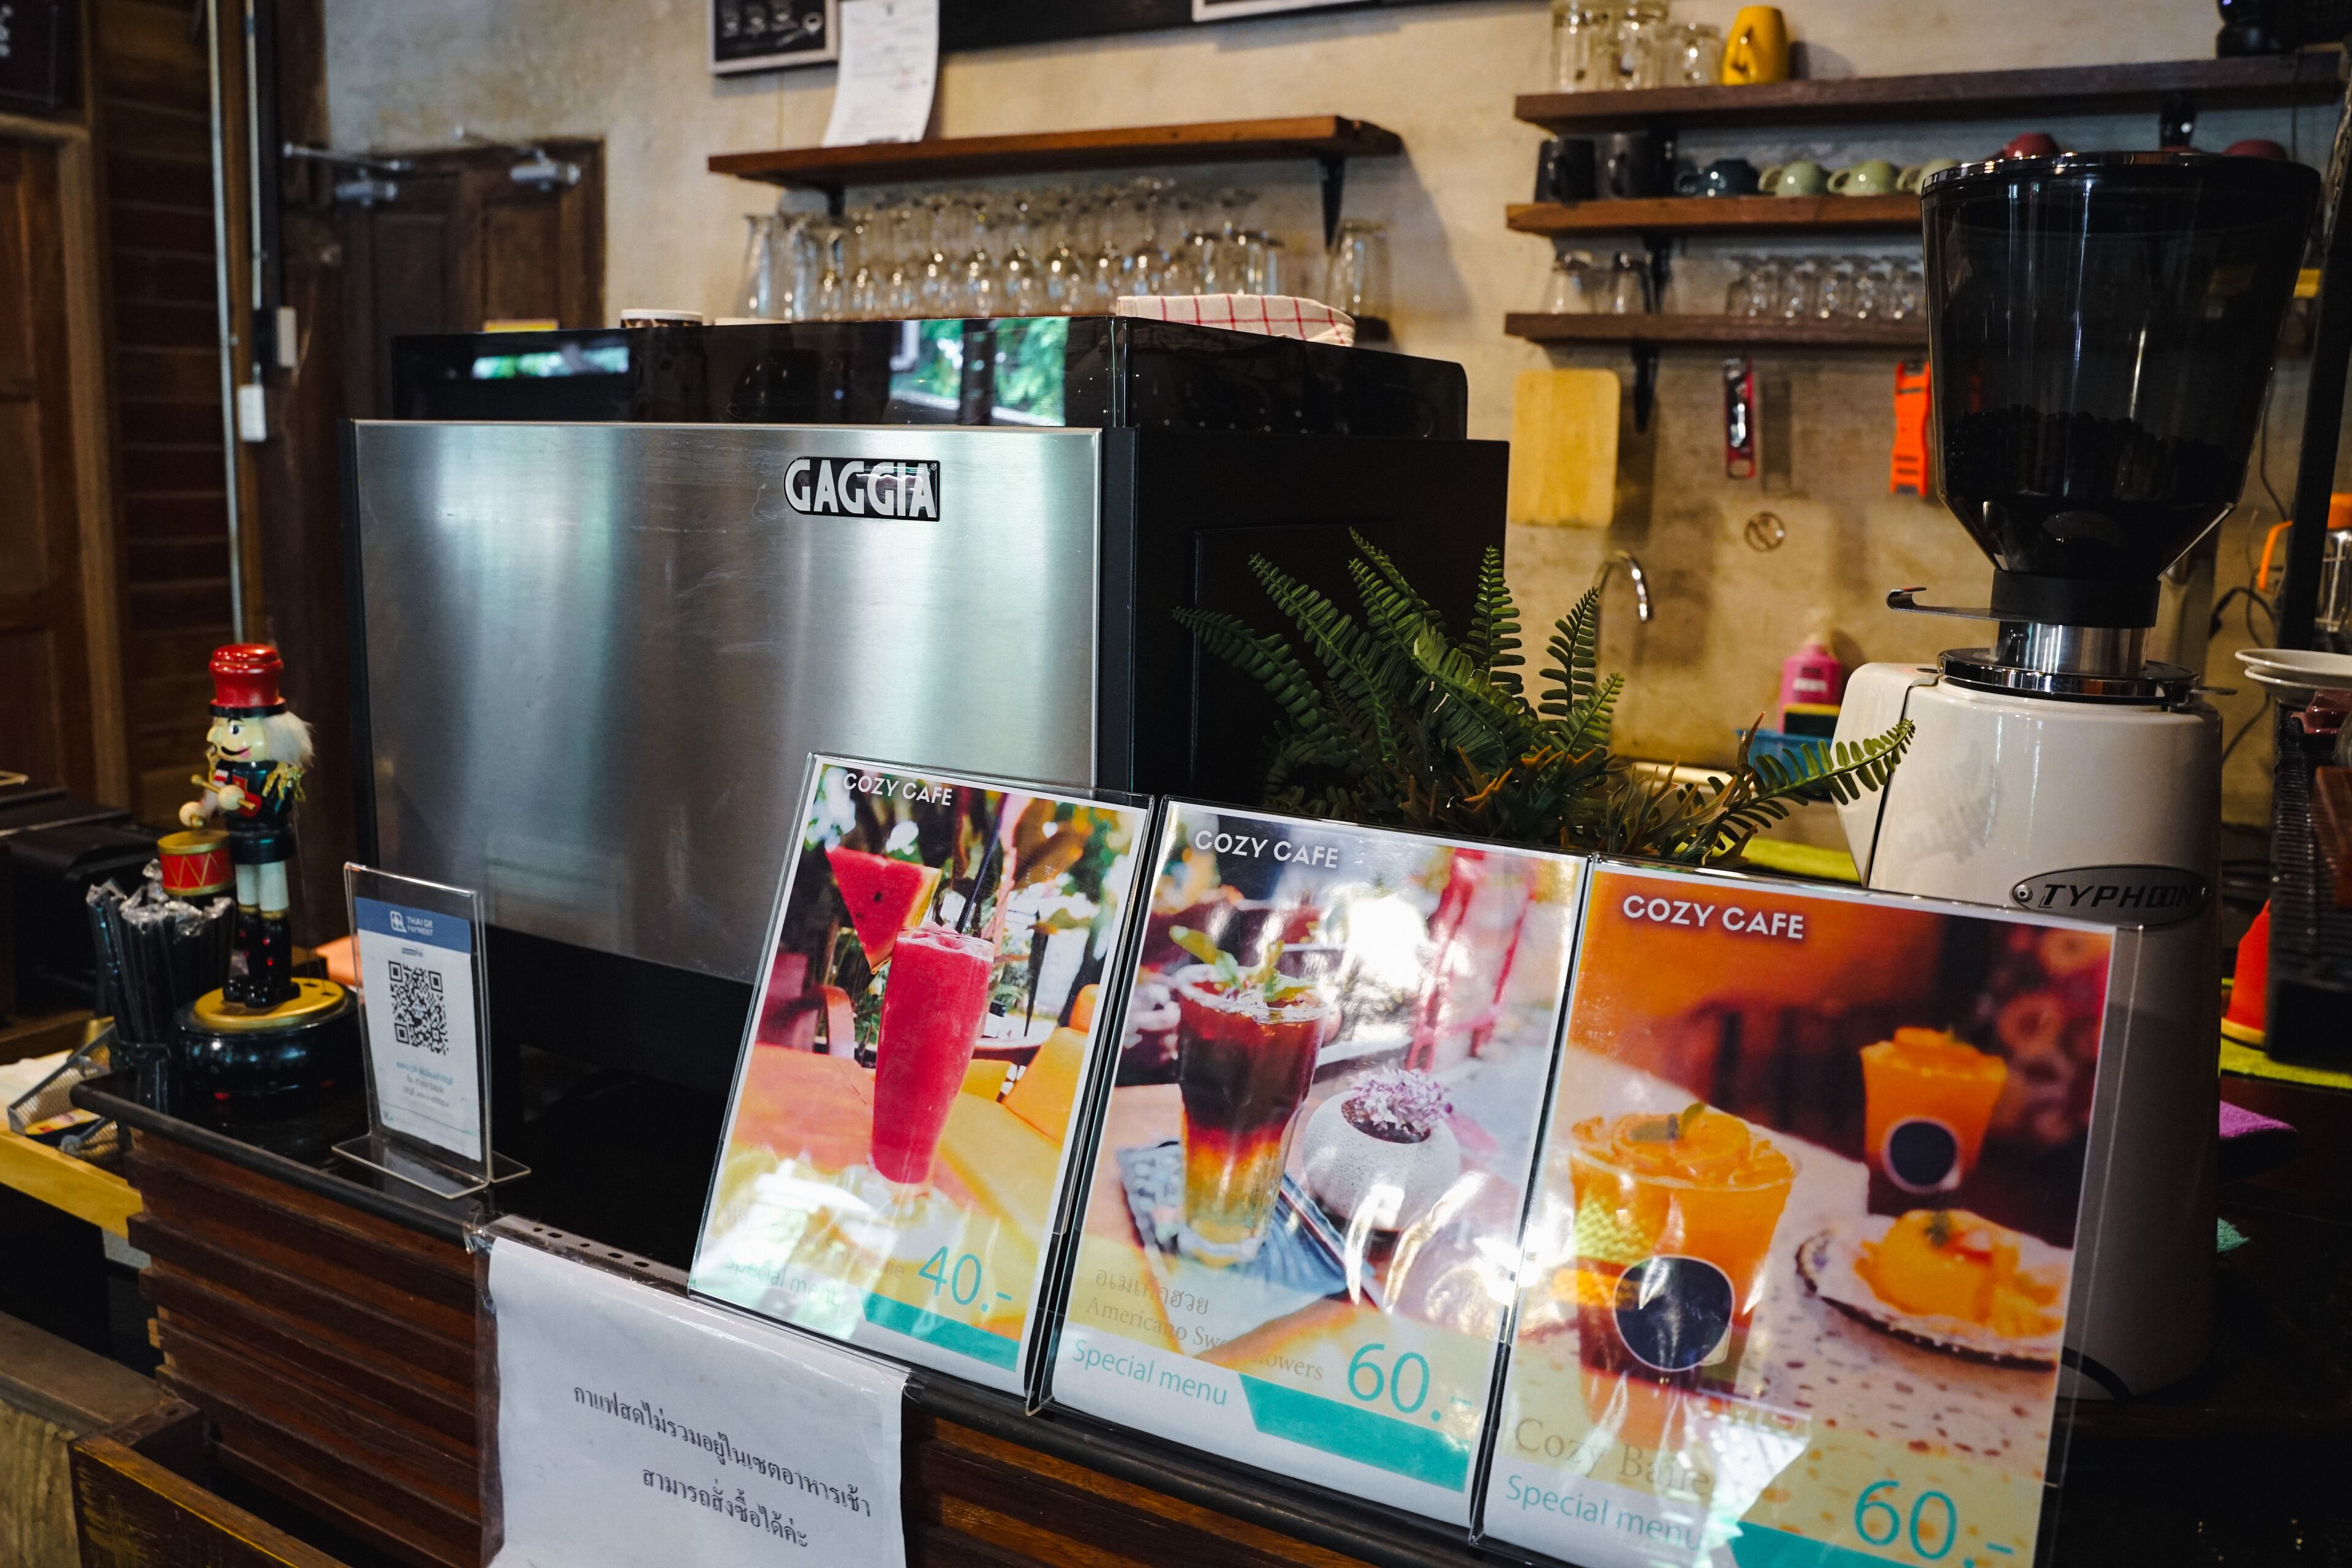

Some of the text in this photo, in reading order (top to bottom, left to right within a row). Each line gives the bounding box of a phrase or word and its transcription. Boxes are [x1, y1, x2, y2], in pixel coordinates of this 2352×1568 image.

[785, 459, 937, 518] GAGGIA
[843, 773, 953, 806] COZY CAFE
[1195, 830, 1339, 869] COZY CAFE
[1623, 895, 1804, 940] COZY CAFE
[2038, 884, 2196, 908] TYPHOON
[407, 916, 423, 927] THAI
[1086, 1297, 1187, 1341] Americano
[1072, 1340, 1227, 1406] Special menu
[1506, 1475, 1703, 1551] Special menu
